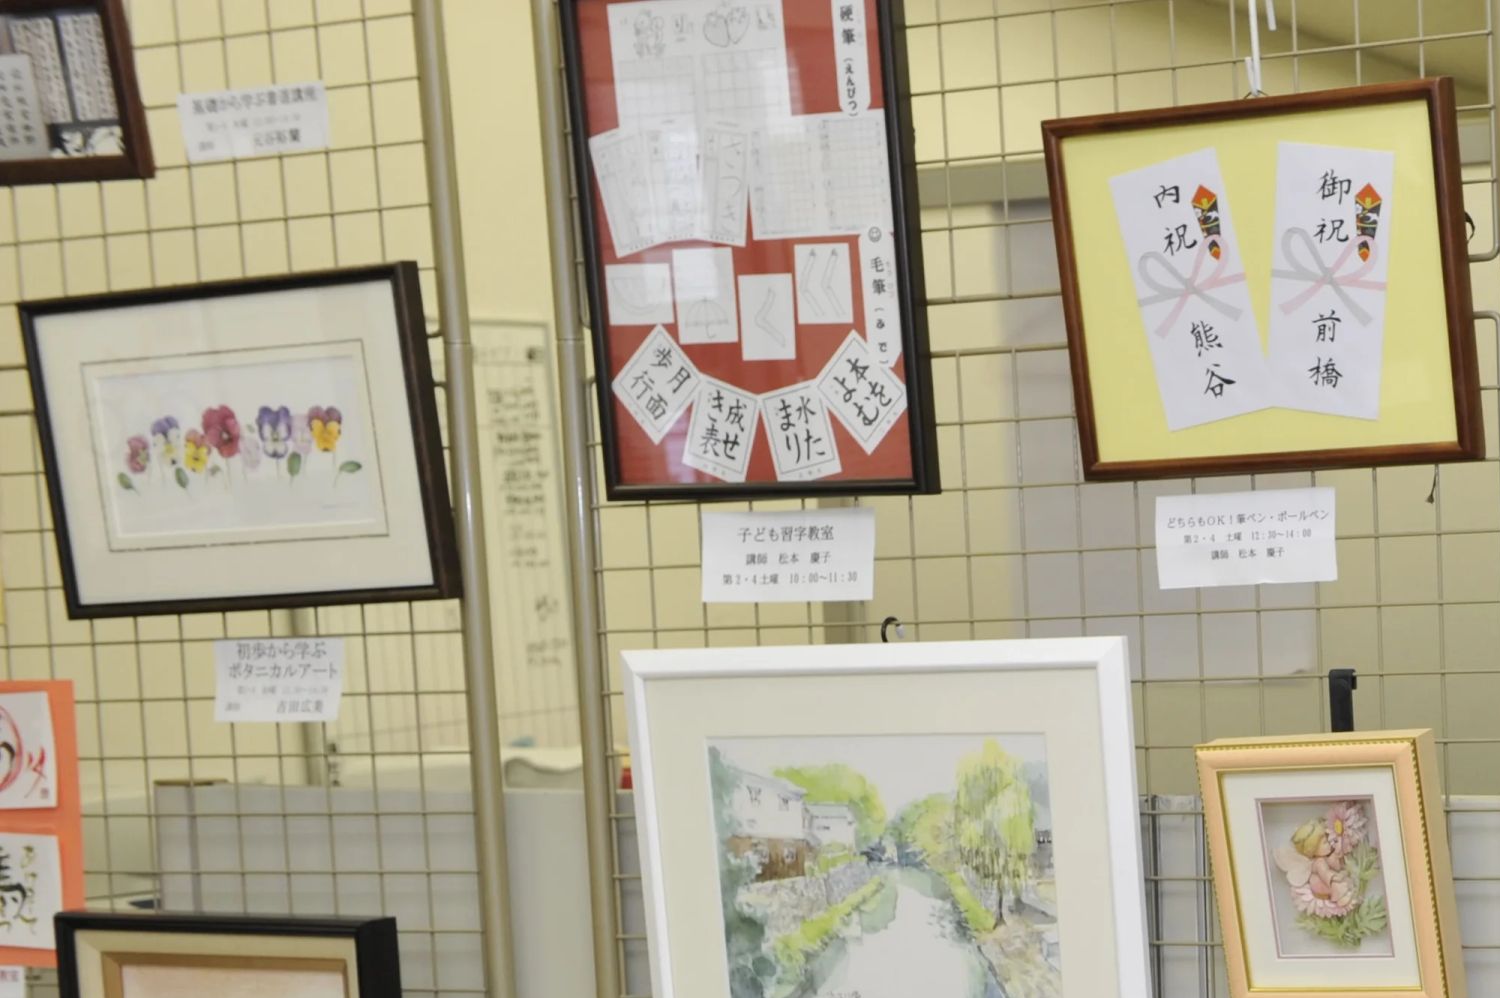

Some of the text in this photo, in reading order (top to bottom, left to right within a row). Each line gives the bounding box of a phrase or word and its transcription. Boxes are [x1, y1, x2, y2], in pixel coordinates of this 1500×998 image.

[1308, 168, 1352, 388] 御祝 前橋
[1190, 320, 1236, 397] 熊谷
[737, 525, 835, 543] 子ども習字教室
[746, 553, 768, 565] 講師
[778, 552, 799, 564] 松本
[237, 641, 327, 660] 初歩から学ぶ
[228, 662, 338, 679] ボタニカルアート
